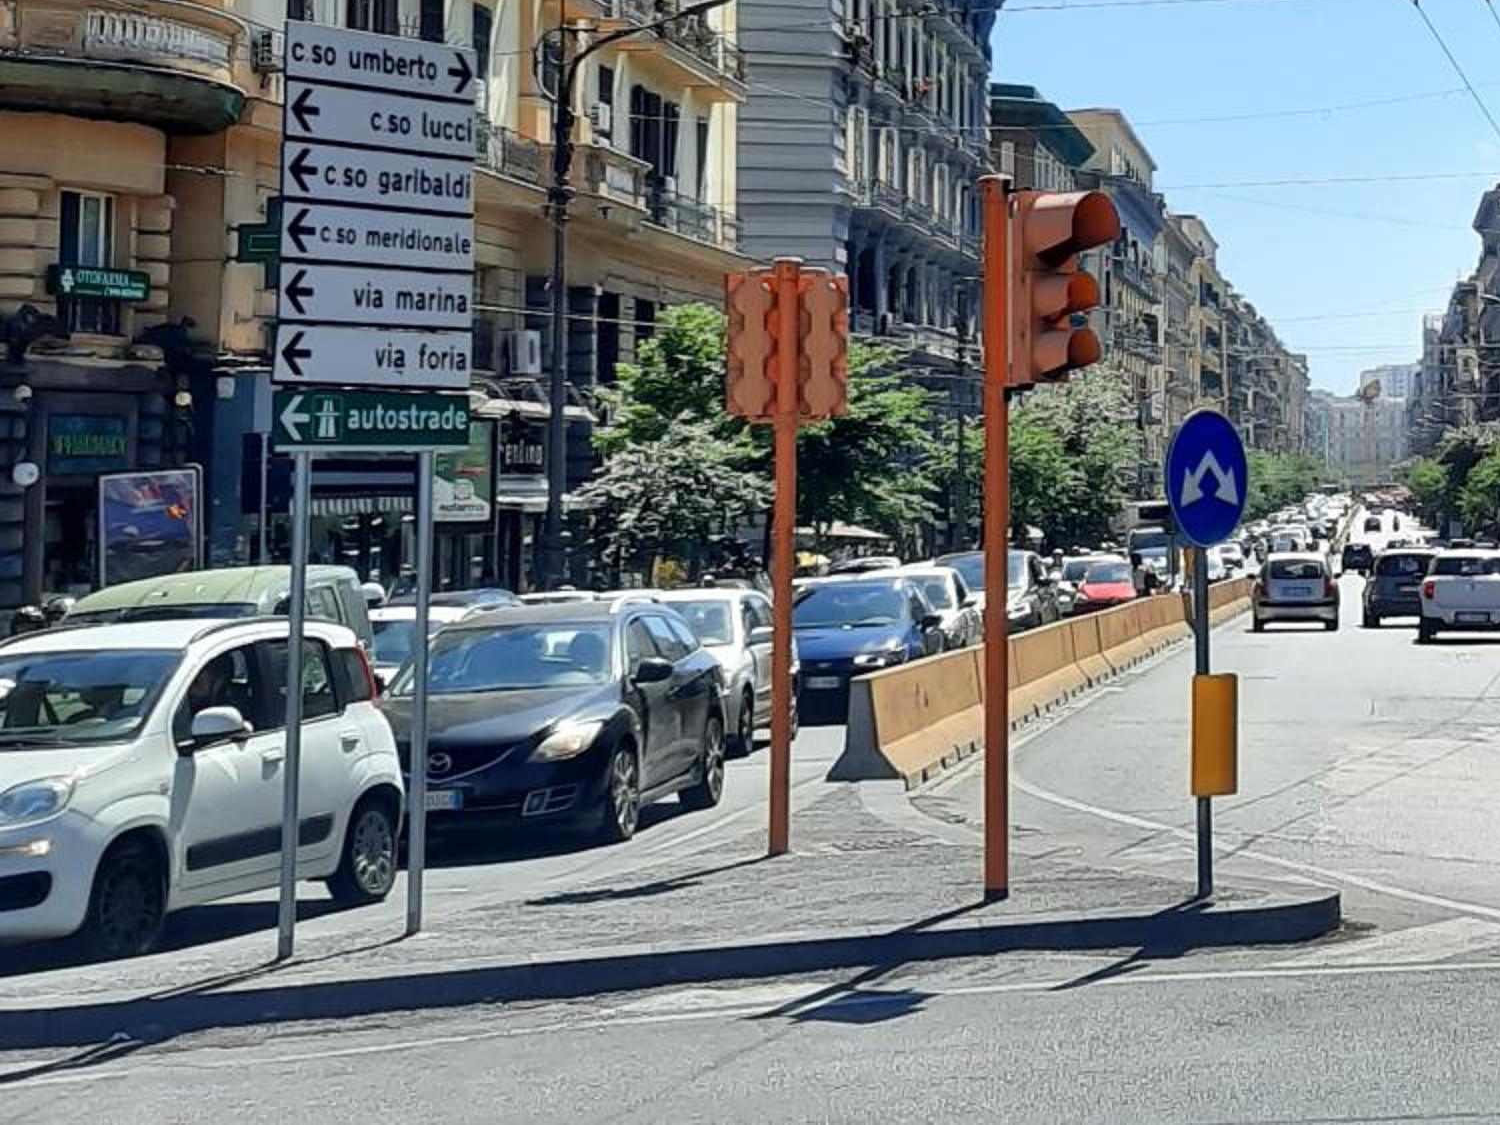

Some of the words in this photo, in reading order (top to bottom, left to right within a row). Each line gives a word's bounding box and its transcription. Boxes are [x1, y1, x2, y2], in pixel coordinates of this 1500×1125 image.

[292, 39, 337, 65] c.so
[349, 49, 438, 82] umberto
[370, 113, 412, 136] c.so
[422, 113, 472, 144] lucci
[323, 166, 367, 188] c.so
[378, 166, 471, 200] garibaldi
[319, 225, 357, 246] c.so
[366, 225, 471, 255] meridionale
[353, 282, 384, 309] via
[395, 288, 468, 313] marina
[375, 342, 406, 371] via
[418, 343, 467, 372] foria
[347, 403, 468, 432] autostrade
